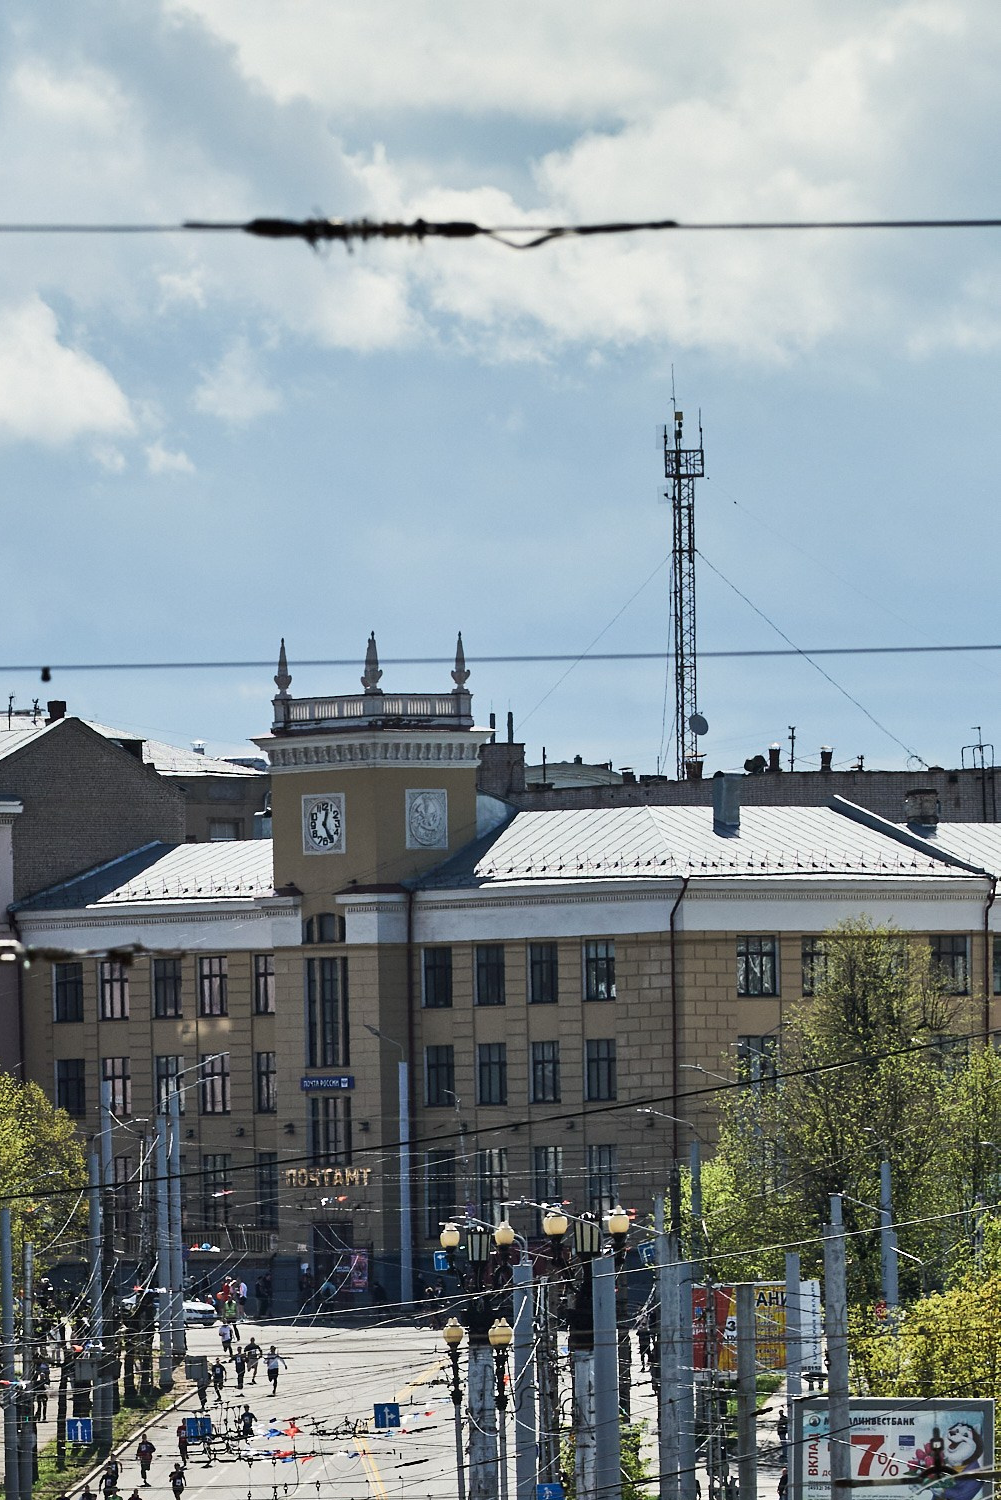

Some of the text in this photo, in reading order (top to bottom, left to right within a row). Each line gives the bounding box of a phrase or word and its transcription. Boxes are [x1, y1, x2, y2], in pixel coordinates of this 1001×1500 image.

[303, 1079, 340, 1088] ПОЧТА РОССИИ
[285, 1168, 372, 1186] ПОЧТАМТ
